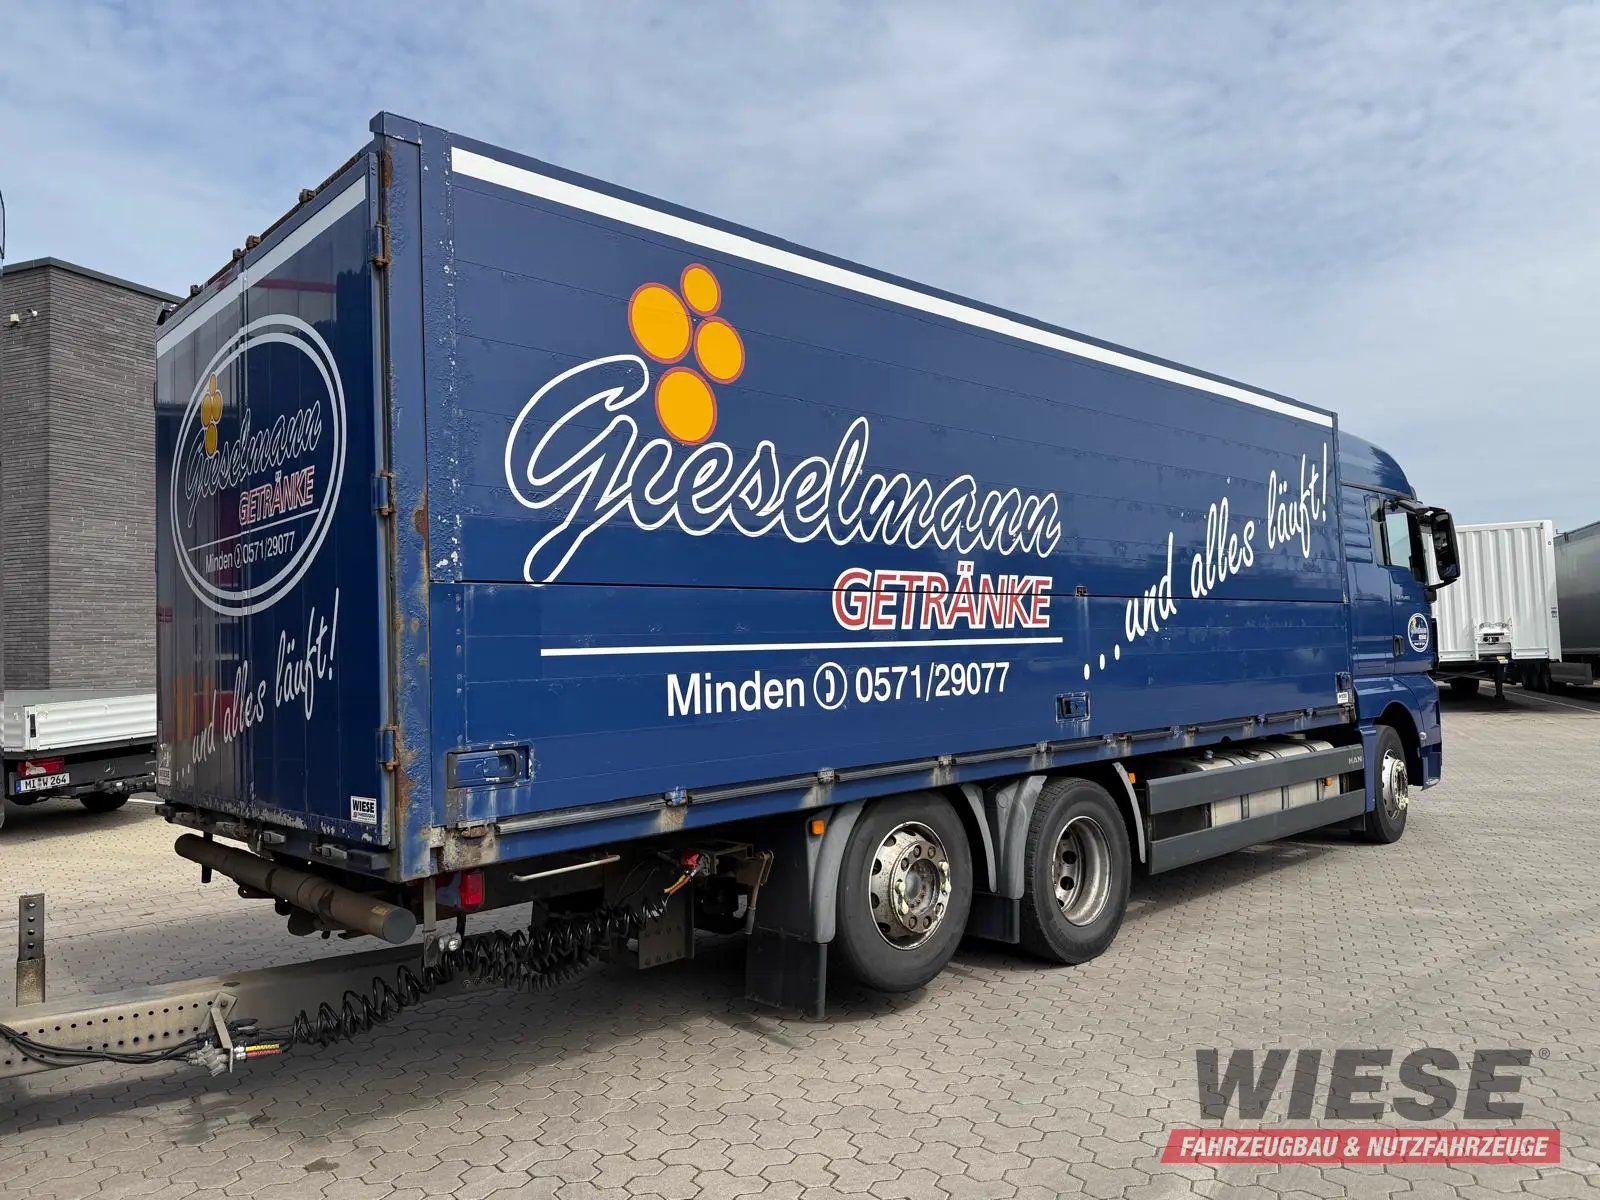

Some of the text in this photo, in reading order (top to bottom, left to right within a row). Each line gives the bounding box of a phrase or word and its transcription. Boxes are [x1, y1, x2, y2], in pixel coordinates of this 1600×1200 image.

[239, 465, 315, 526] GETRÄNKE
[504, 354, 1061, 587] Gieselmann
[1190, 496, 1255, 600] alles
[1267, 442, 1327, 559] läuft!
[205, 531, 296, 574] Minden 0571/29077
[831, 560, 1053, 630] GETRÄNKE
[223, 660, 266, 744] alles
[275, 587, 340, 720] läuft!
[667, 661, 1011, 717] Minden 0571/29077
[24, 780, 36, 790] MI
[50, 775, 67, 786] 264
[352, 799, 375, 813] WIESE
